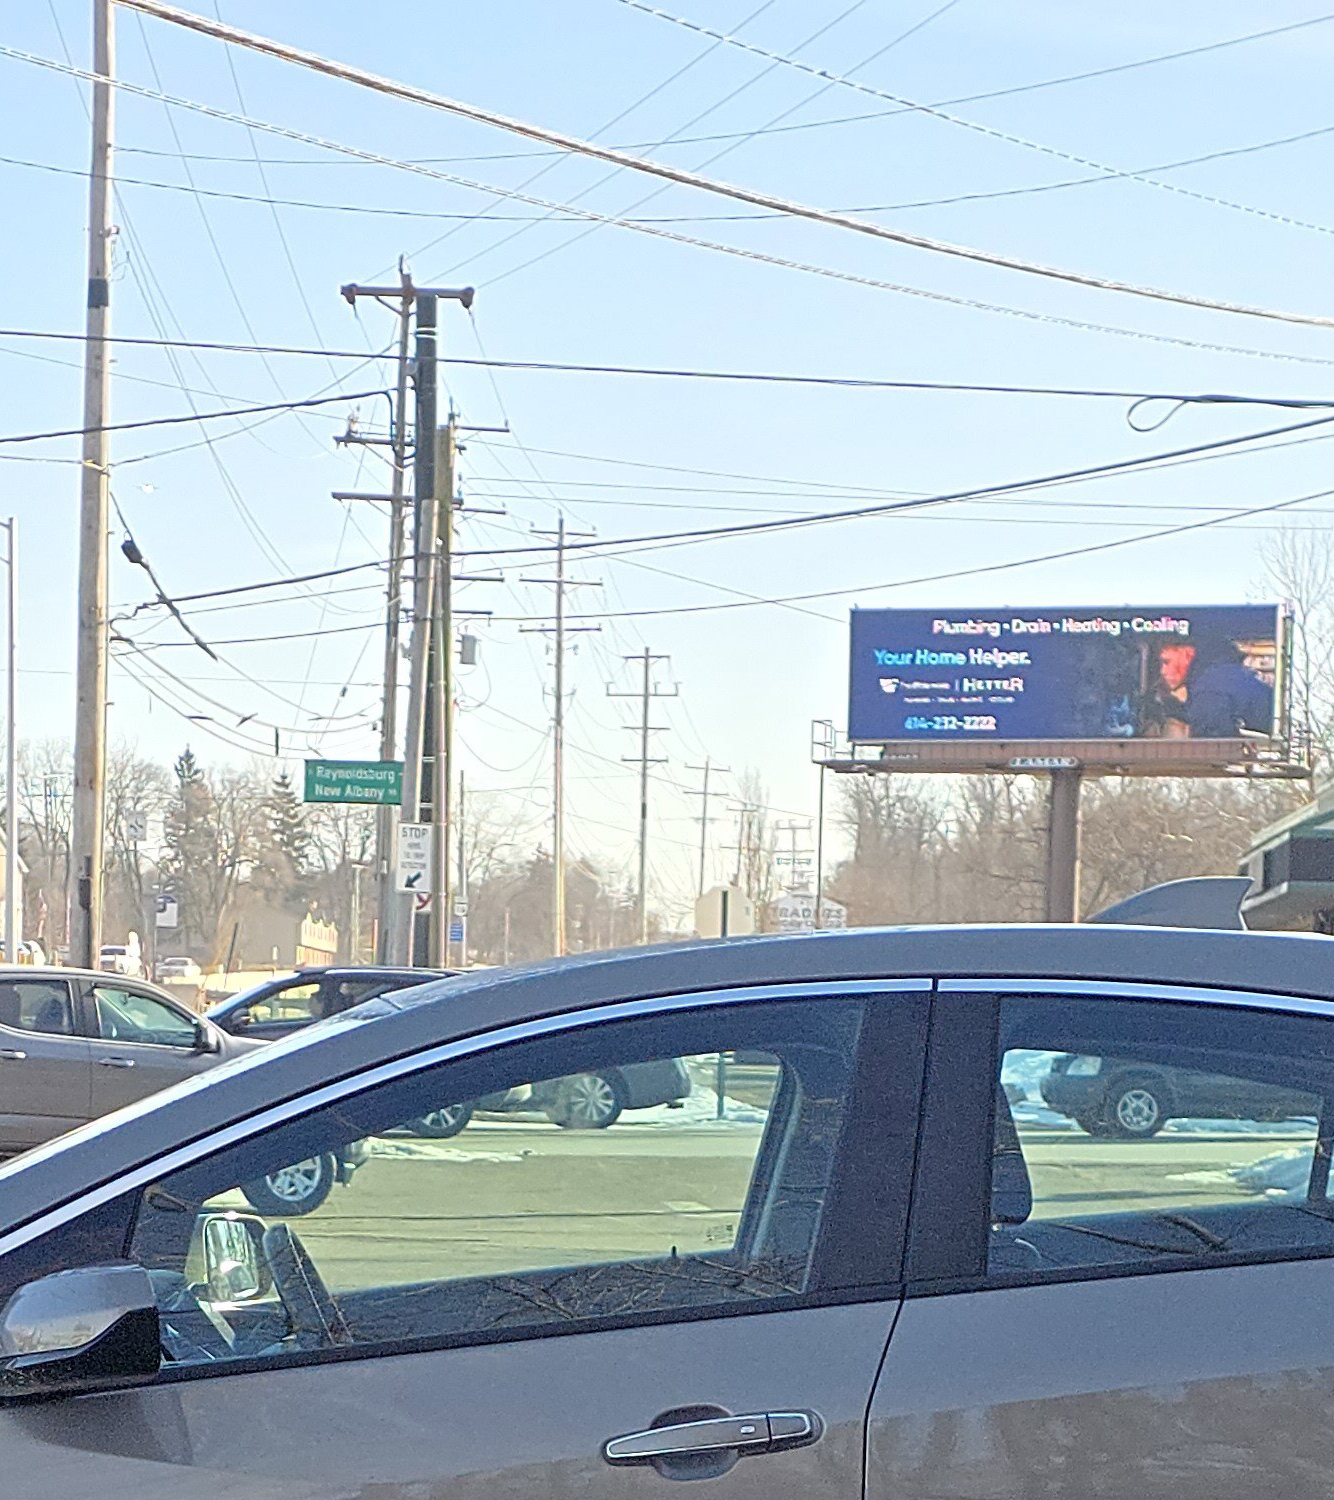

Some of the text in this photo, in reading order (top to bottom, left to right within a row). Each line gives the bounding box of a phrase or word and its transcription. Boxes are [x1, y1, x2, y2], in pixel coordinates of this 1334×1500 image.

[932, 616, 1190, 637] Plumbing Drain Heating Cooling
[874, 648, 913, 666] Your
[915, 648, 967, 666] Home
[314, 783, 342, 797] New
[344, 783, 385, 801] Albany
[401, 826, 429, 839] STOP
